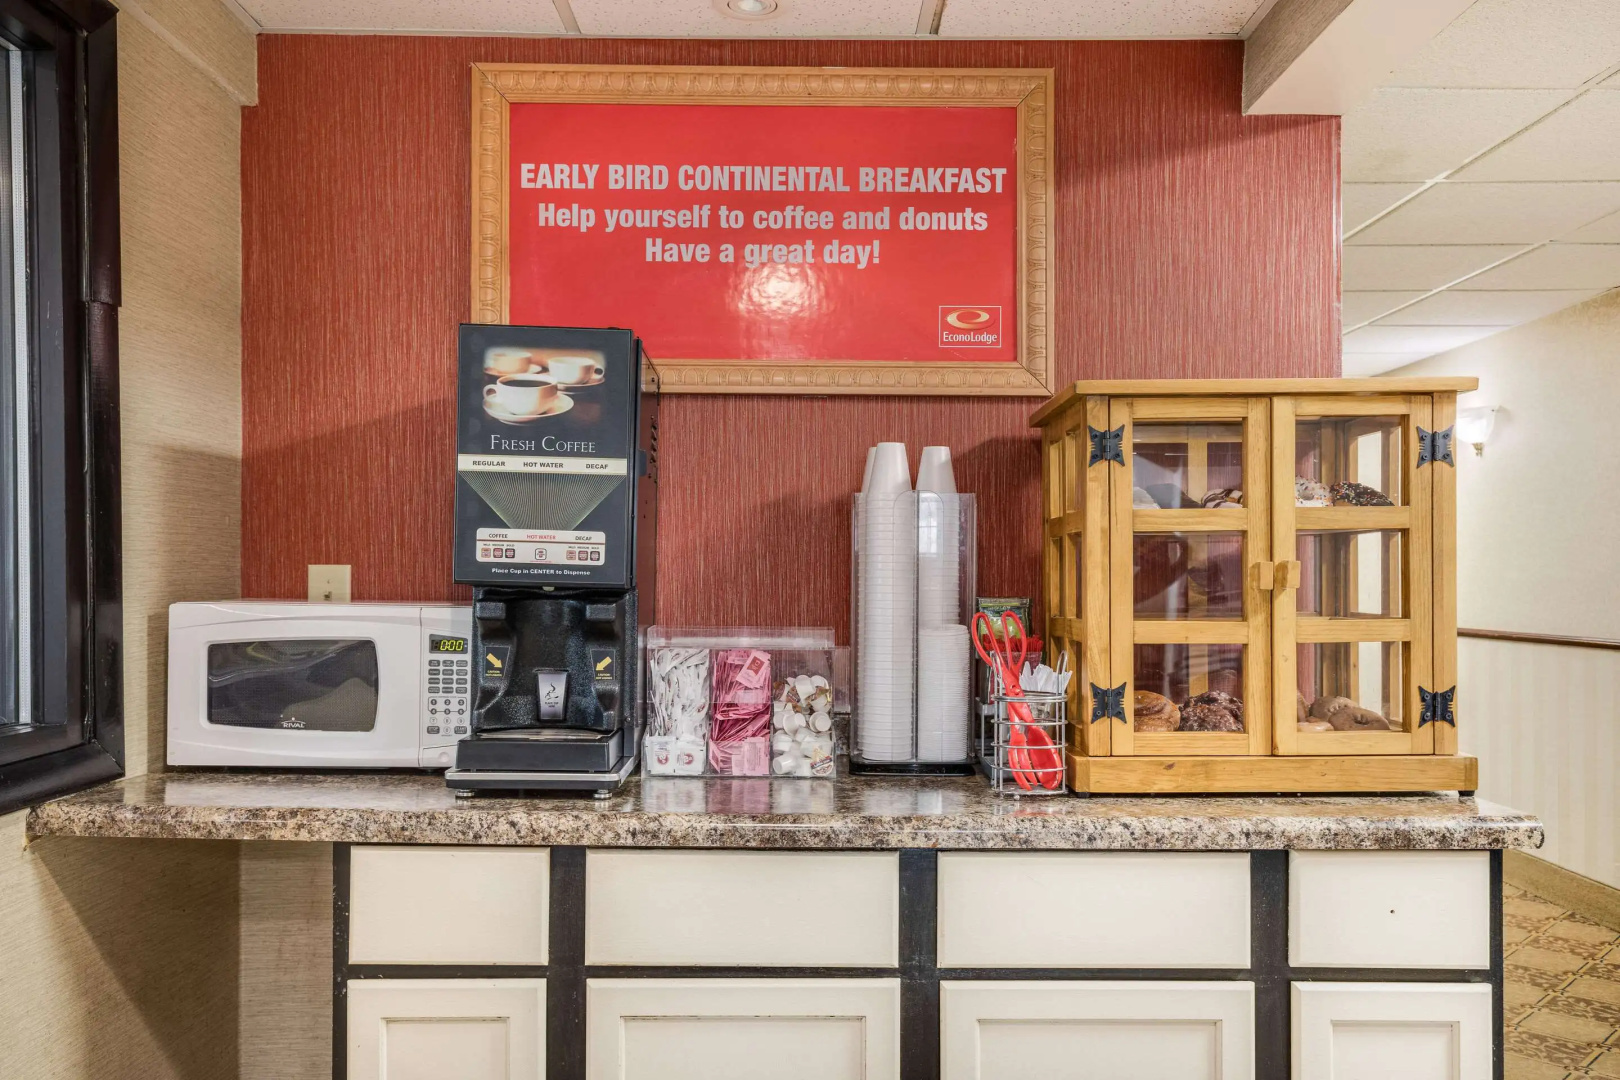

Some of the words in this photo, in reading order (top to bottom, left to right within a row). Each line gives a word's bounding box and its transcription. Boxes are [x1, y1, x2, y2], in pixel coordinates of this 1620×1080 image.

[520, 163, 600, 190] EARLY
[608, 164, 668, 190] BIRD
[678, 165, 850, 192] CONTINENTAL
[858, 167, 1007, 194] BREAKFAST
[538, 203, 596, 232] Help
[604, 204, 710, 232] yourself
[718, 206, 744, 228] to
[752, 205, 834, 230] coffee
[842, 206, 890, 230] and
[899, 208, 988, 232] donuts
[645, 238, 711, 263] Have
[718, 244, 735, 264] a
[744, 242, 814, 269] great
[822, 240, 880, 270] day!
[943, 332, 997, 344] EconoLodge
